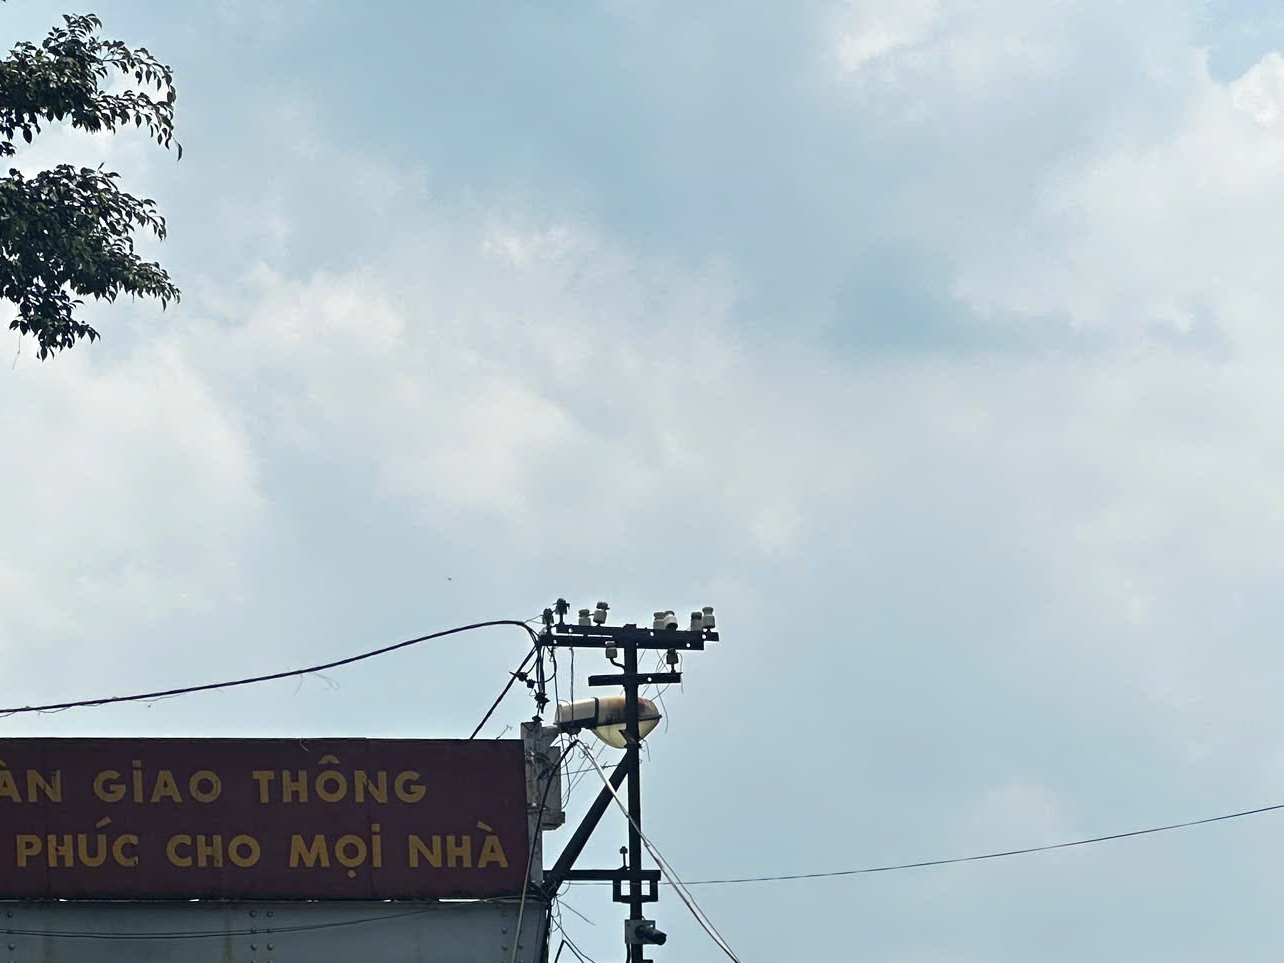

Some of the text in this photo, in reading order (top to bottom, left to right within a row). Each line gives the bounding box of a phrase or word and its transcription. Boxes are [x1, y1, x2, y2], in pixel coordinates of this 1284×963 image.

[252, 754, 427, 803] THÔNG
[16, 815, 139, 868] PHÚC
[165, 834, 262, 868] CHO
[407, 820, 509, 868] NHÀ
